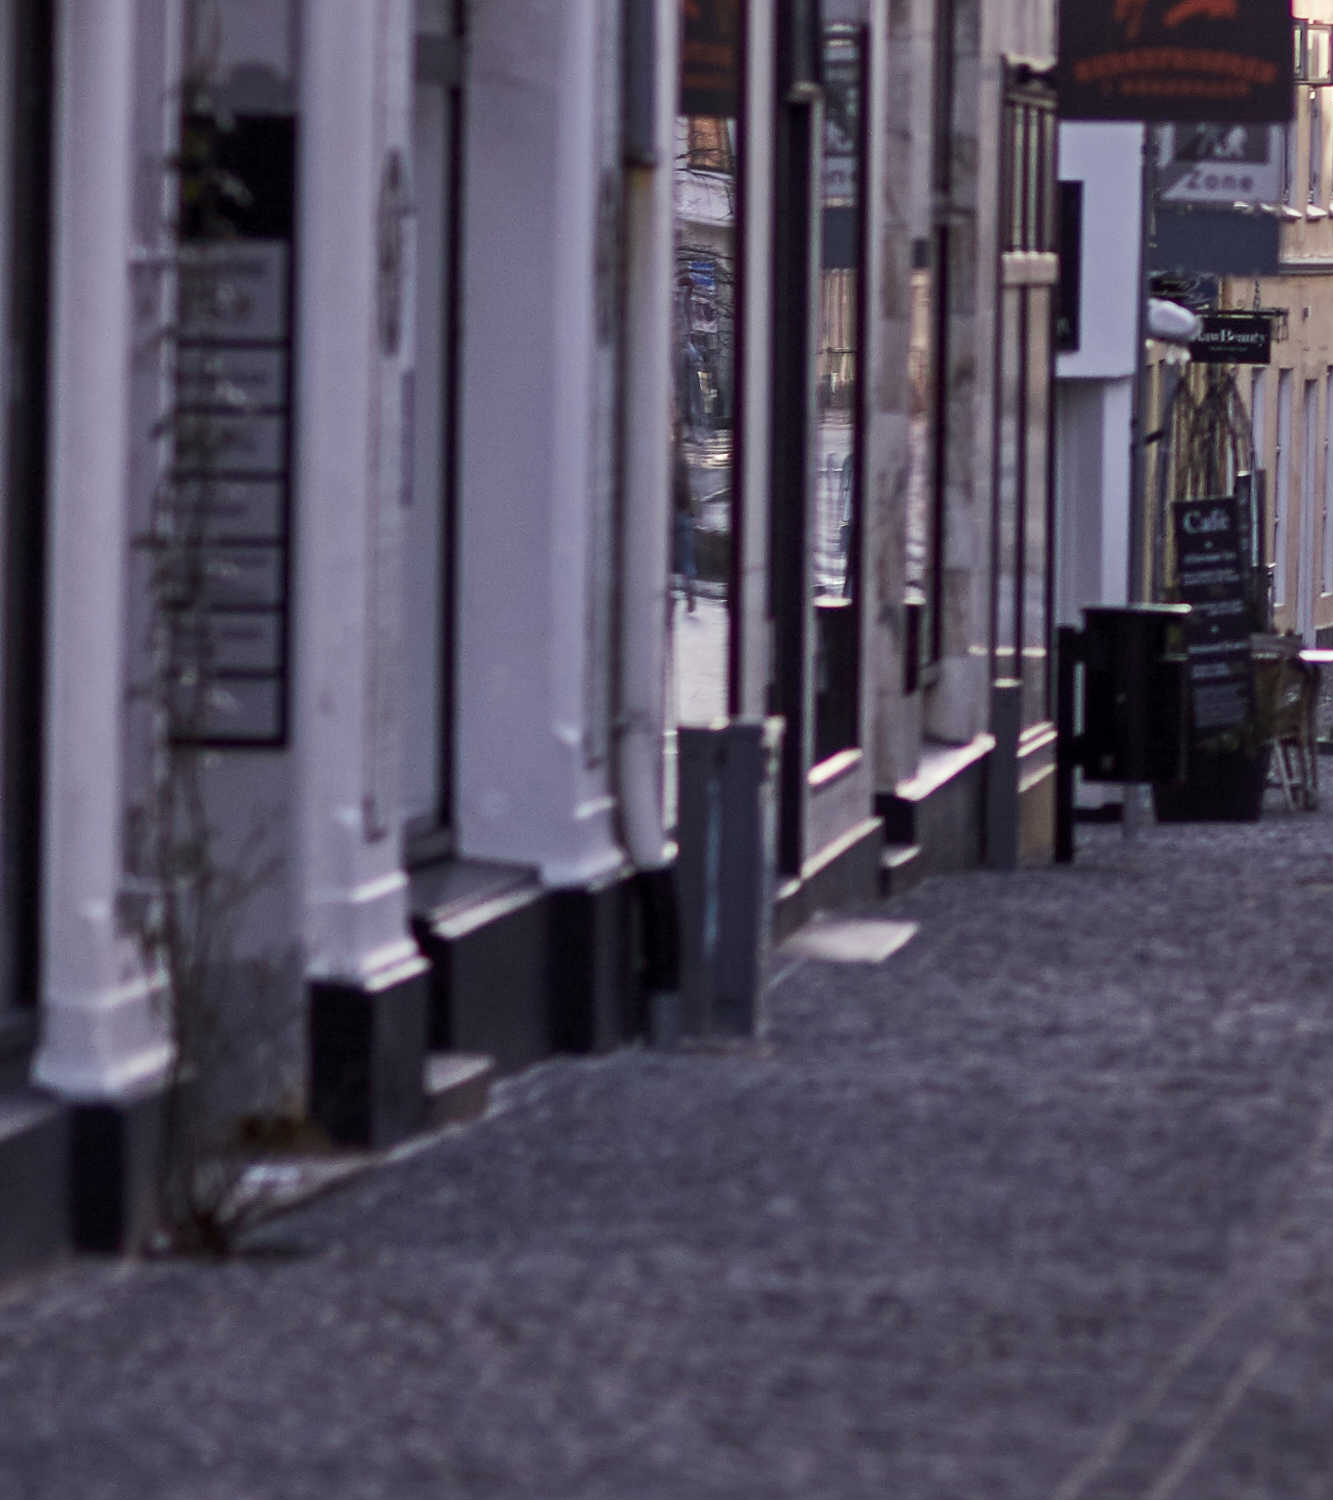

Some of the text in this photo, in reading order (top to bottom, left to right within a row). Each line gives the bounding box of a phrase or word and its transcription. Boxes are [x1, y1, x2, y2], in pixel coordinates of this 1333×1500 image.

[1186, 168, 1255, 193] Zone
[1197, 329, 1265, 347] awBeauty
[1183, 508, 1229, 534] Café
